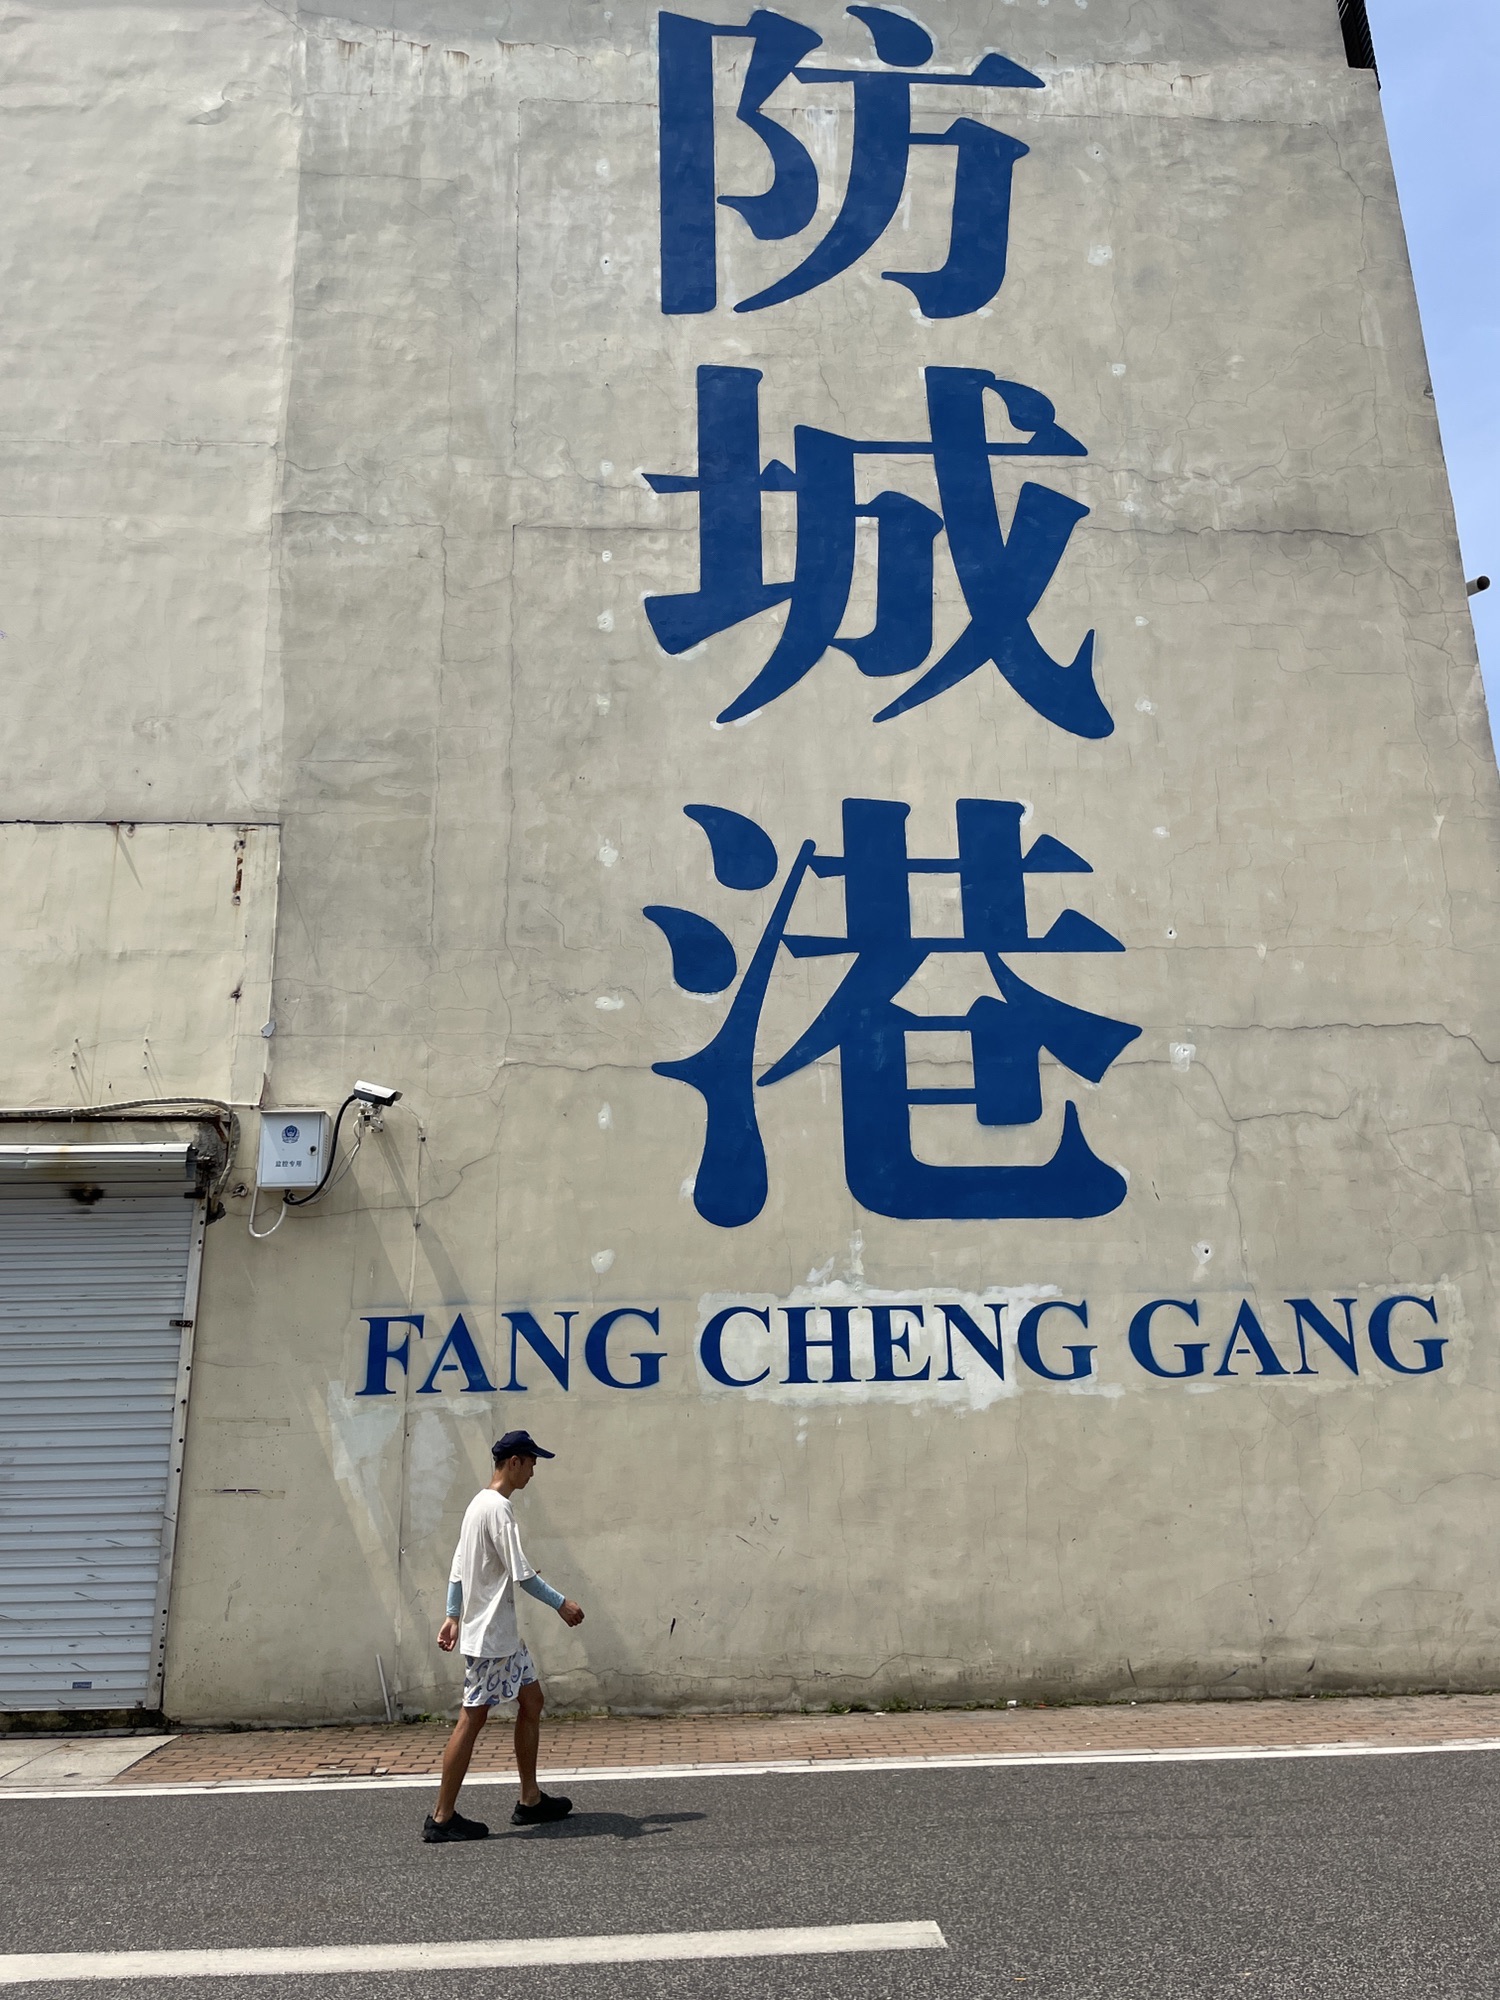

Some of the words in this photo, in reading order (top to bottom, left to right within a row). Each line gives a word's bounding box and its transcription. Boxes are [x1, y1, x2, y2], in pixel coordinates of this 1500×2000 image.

[643, 5, 1142, 1228] 防城港
[274, 1160, 303, 1168] 监控专用
[355, 1306, 667, 1396] FANG
[700, 1301, 1096, 1387] CHENG
[1129, 1295, 1450, 1378] GANG
